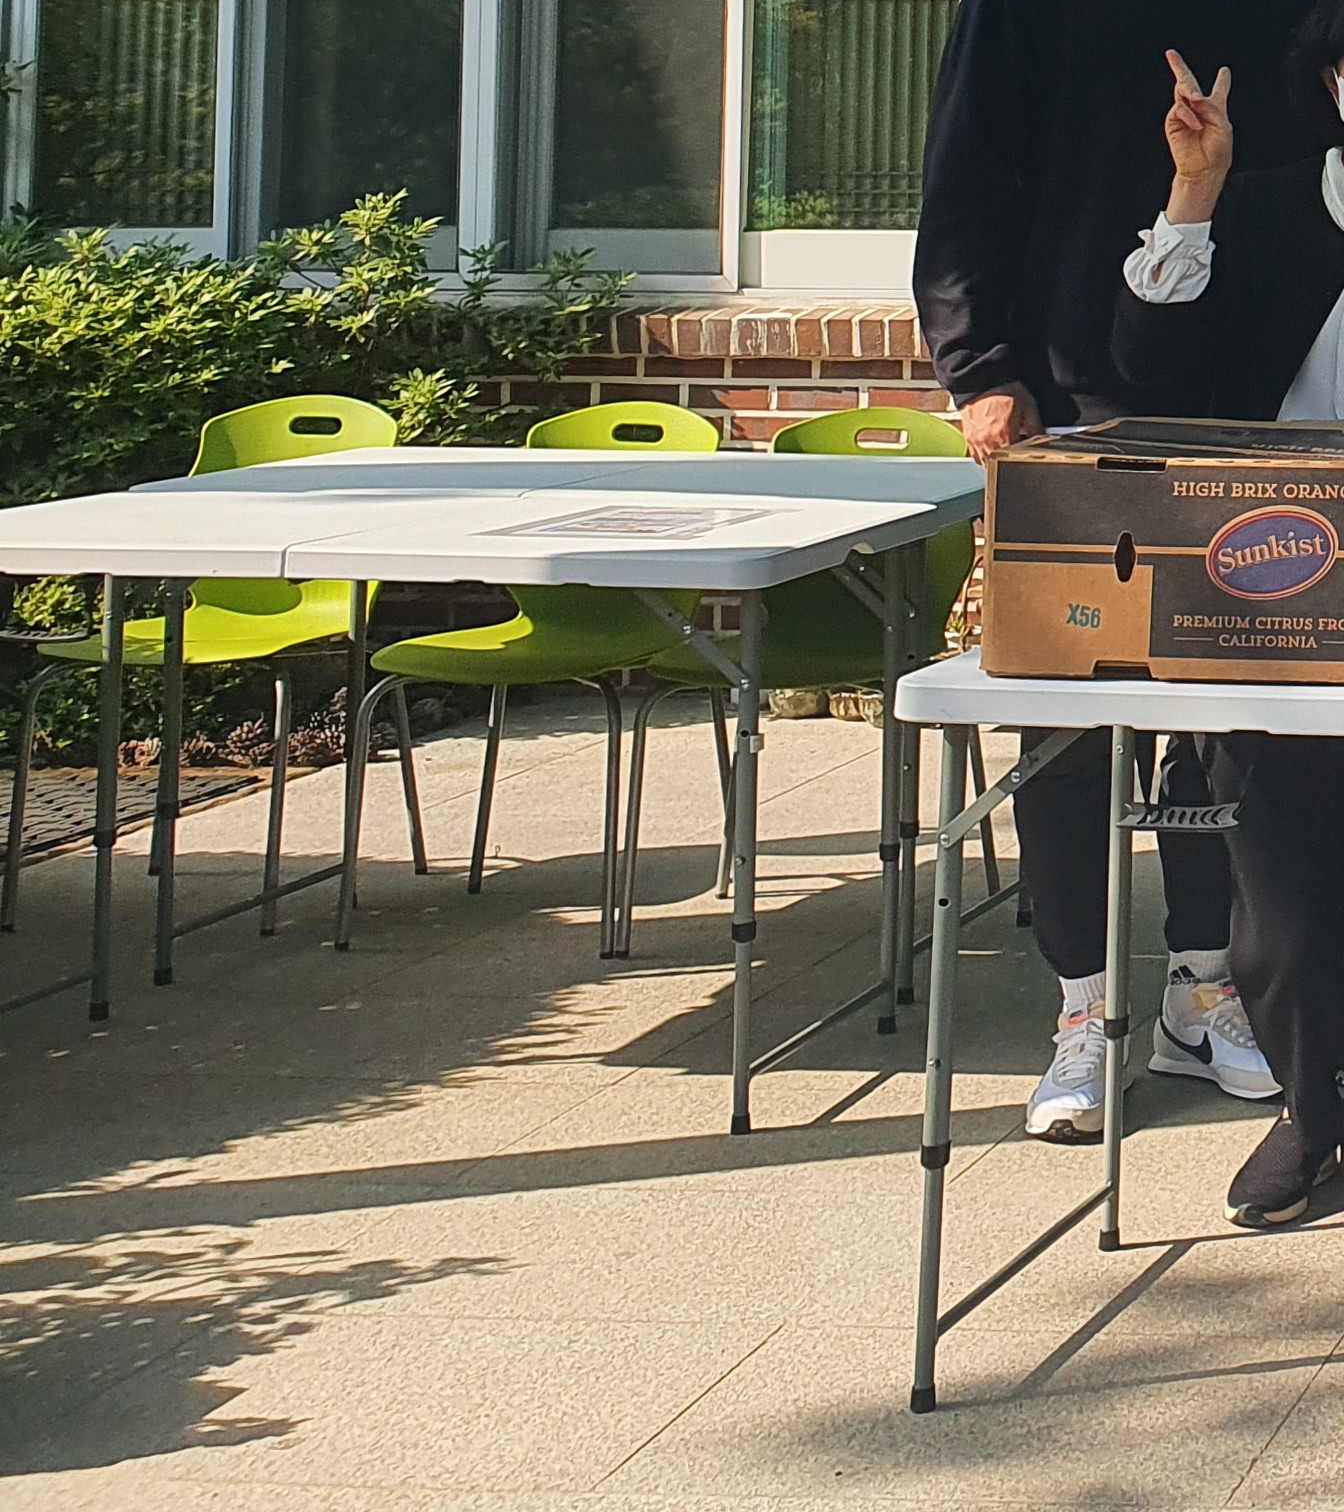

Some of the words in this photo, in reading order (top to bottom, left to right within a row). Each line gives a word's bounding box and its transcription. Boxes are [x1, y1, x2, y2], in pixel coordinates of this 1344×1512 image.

[1172, 481, 1225, 497] HIGH
[1231, 482, 1278, 498] BRIX
[1217, 531, 1326, 576] Sunkist
[1066, 603, 1101, 628] X56
[1173, 615, 1250, 629] PREMIUM
[1255, 617, 1313, 630] CITRUS
[1219, 634, 1318, 649] CALIFORNIA
